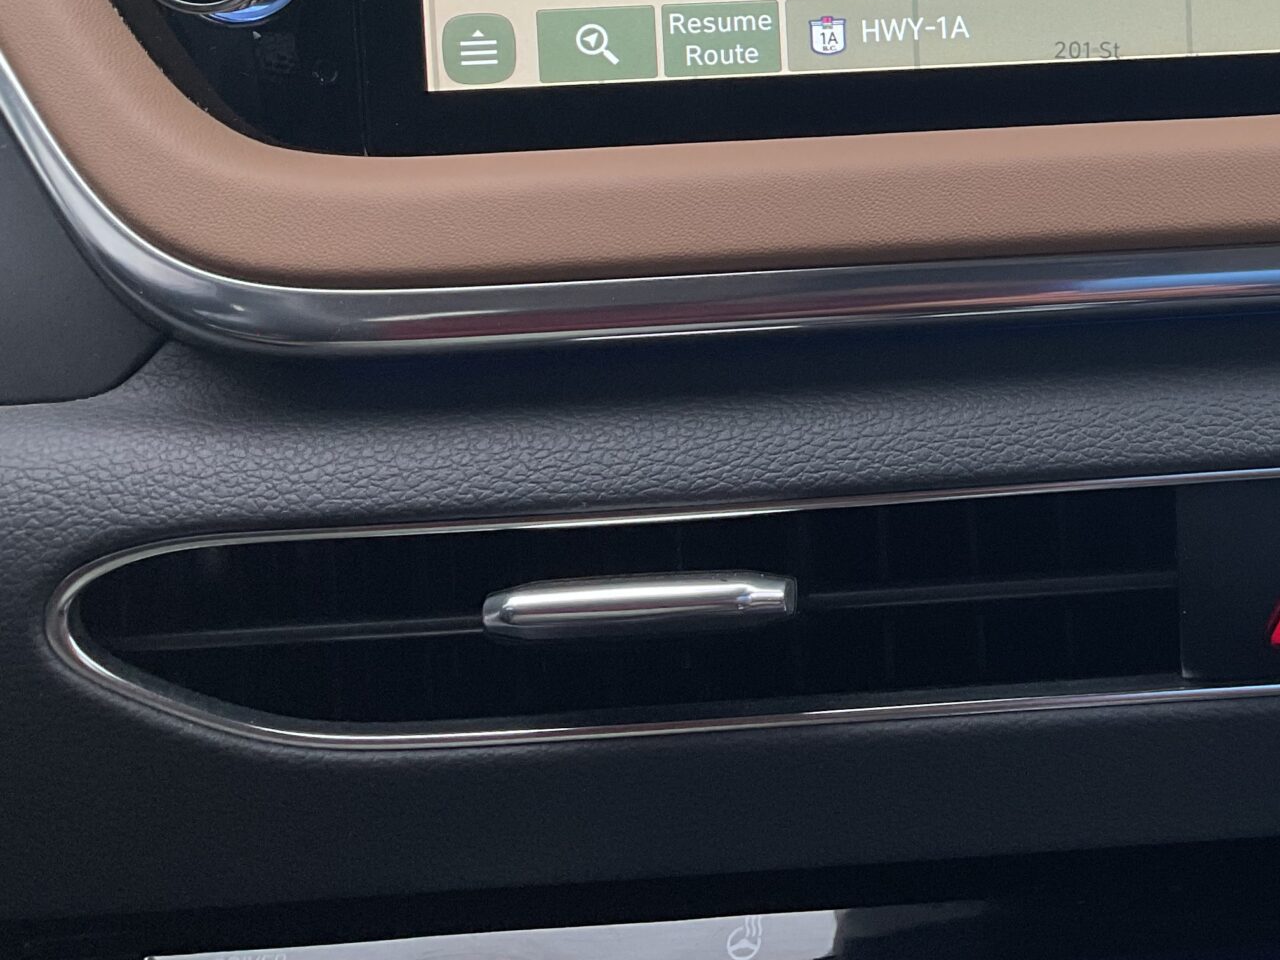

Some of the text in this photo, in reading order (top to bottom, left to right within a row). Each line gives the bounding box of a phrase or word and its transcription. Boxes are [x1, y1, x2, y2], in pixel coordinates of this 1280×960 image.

[669, 13, 772, 35] Resume
[862, 15, 970, 44] HWY-1A
[820, 31, 838, 45] 1A
[686, 44, 759, 67] Route
[1054, 41, 1121, 60] 201 St
